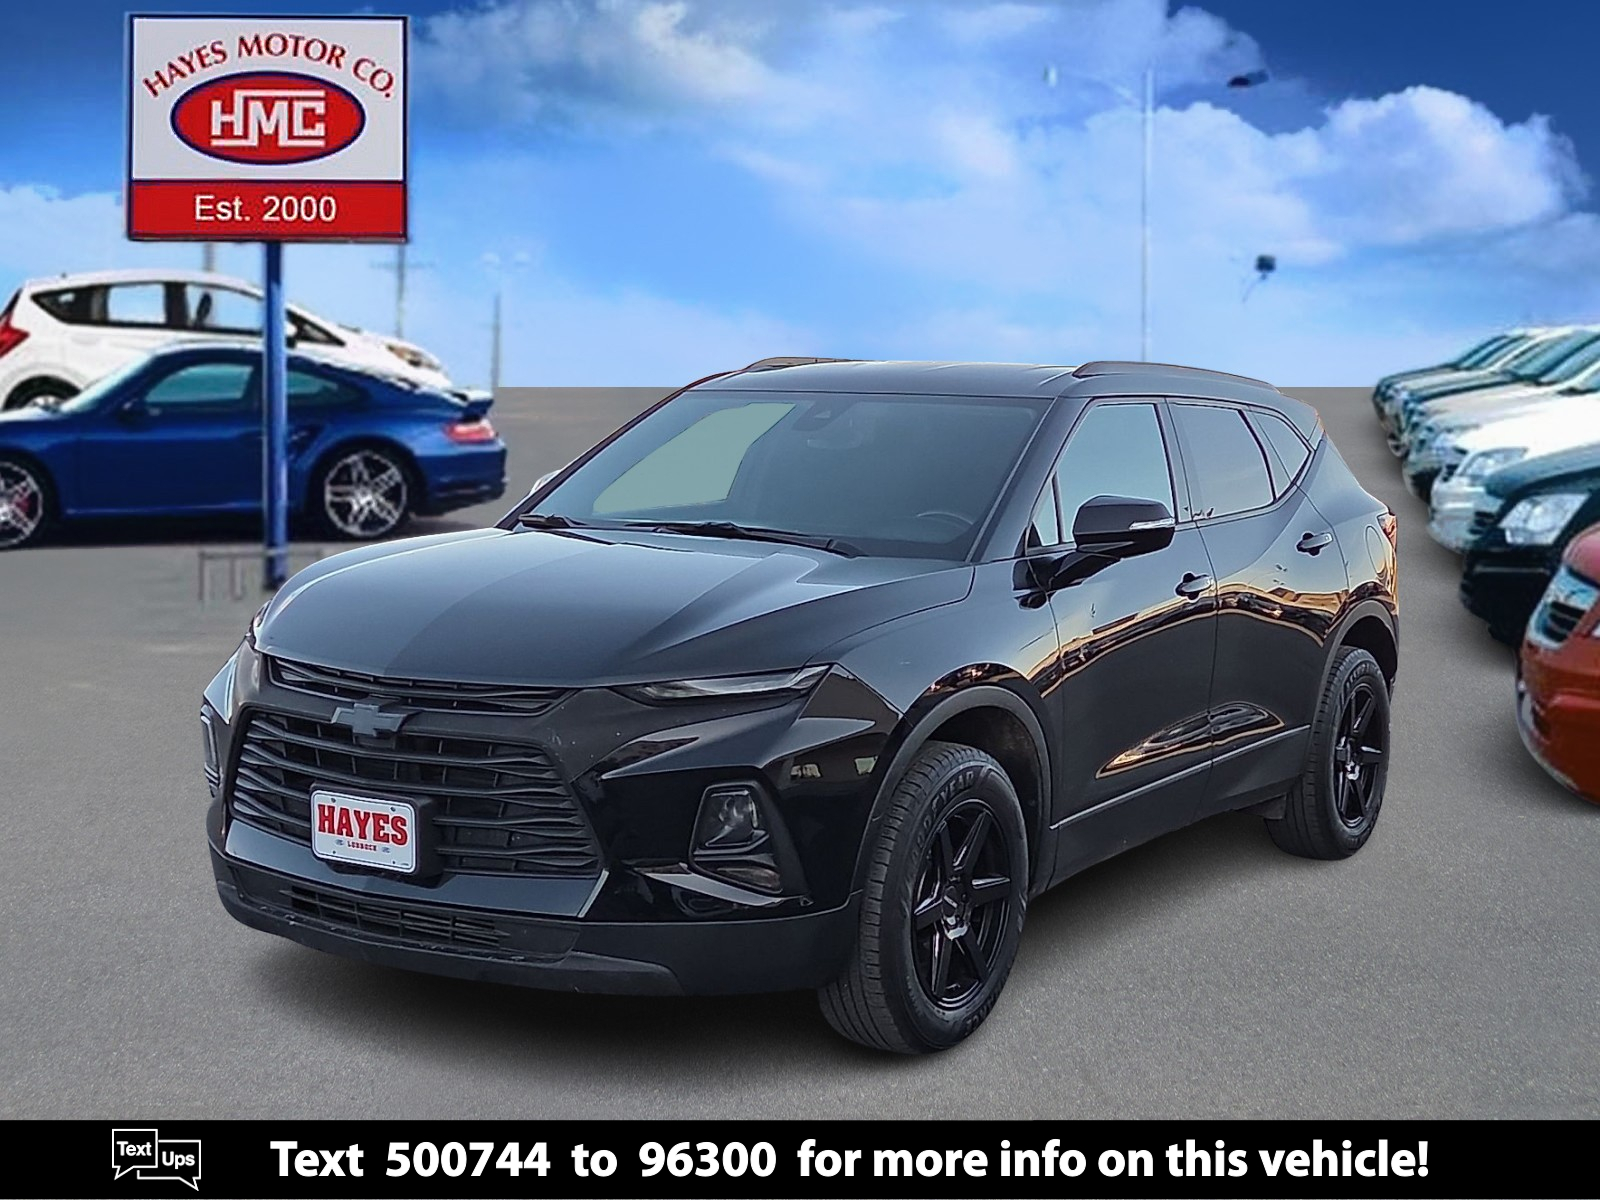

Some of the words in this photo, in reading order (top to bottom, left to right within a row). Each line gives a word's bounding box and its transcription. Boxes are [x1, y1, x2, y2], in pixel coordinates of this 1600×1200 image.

[142, 40, 228, 98] HAYES
[237, 32, 347, 69] MOTOR
[352, 57, 395, 98] CO.
[210, 89, 327, 148] HMC
[194, 195, 251, 222] Est.
[261, 195, 338, 223] 2000
[317, 803, 409, 846] HAYES
